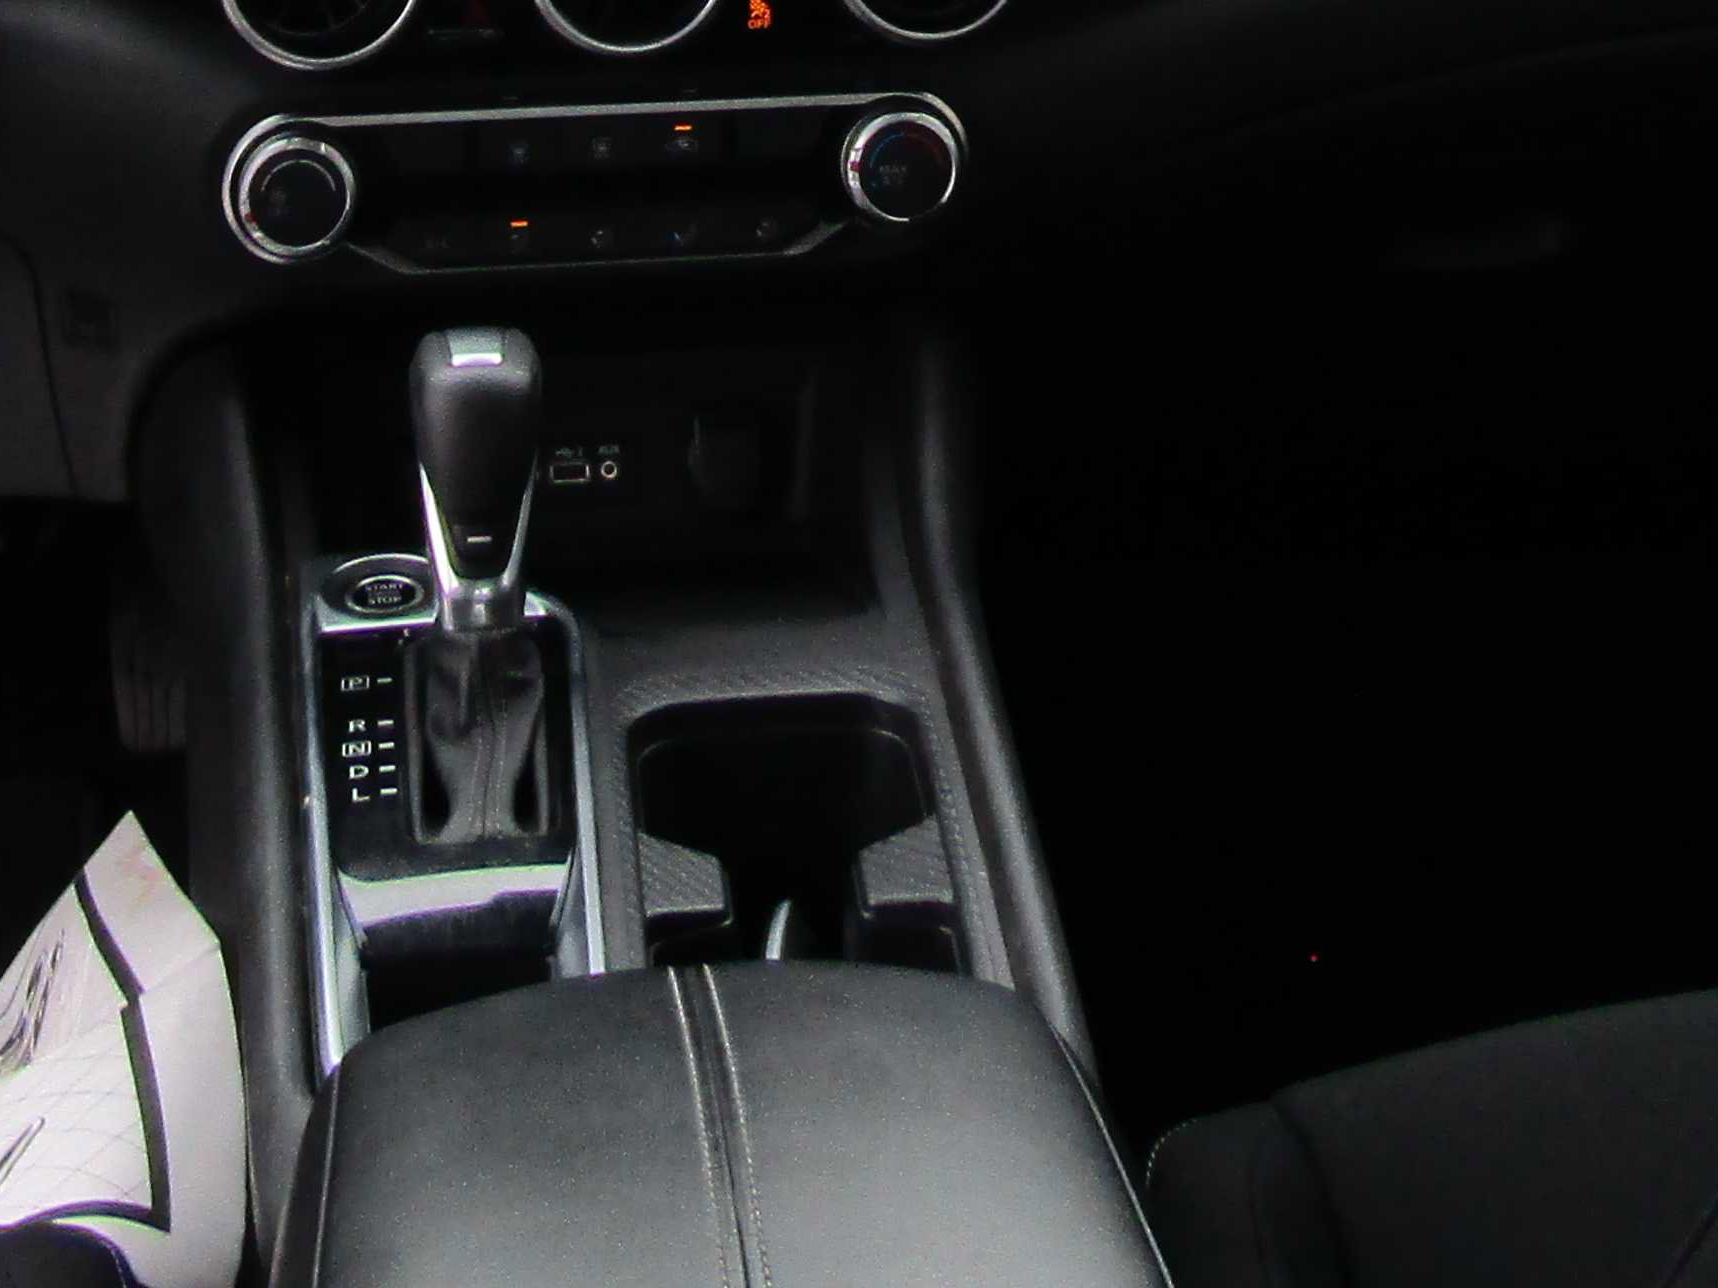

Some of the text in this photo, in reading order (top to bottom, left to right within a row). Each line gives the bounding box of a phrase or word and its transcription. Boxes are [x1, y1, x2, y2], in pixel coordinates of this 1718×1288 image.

[746, 19, 771, 30] OFF
[368, 596, 403, 605] STOP
[348, 719, 366, 733] R
[348, 765, 370, 780] D
[351, 787, 371, 803] L
